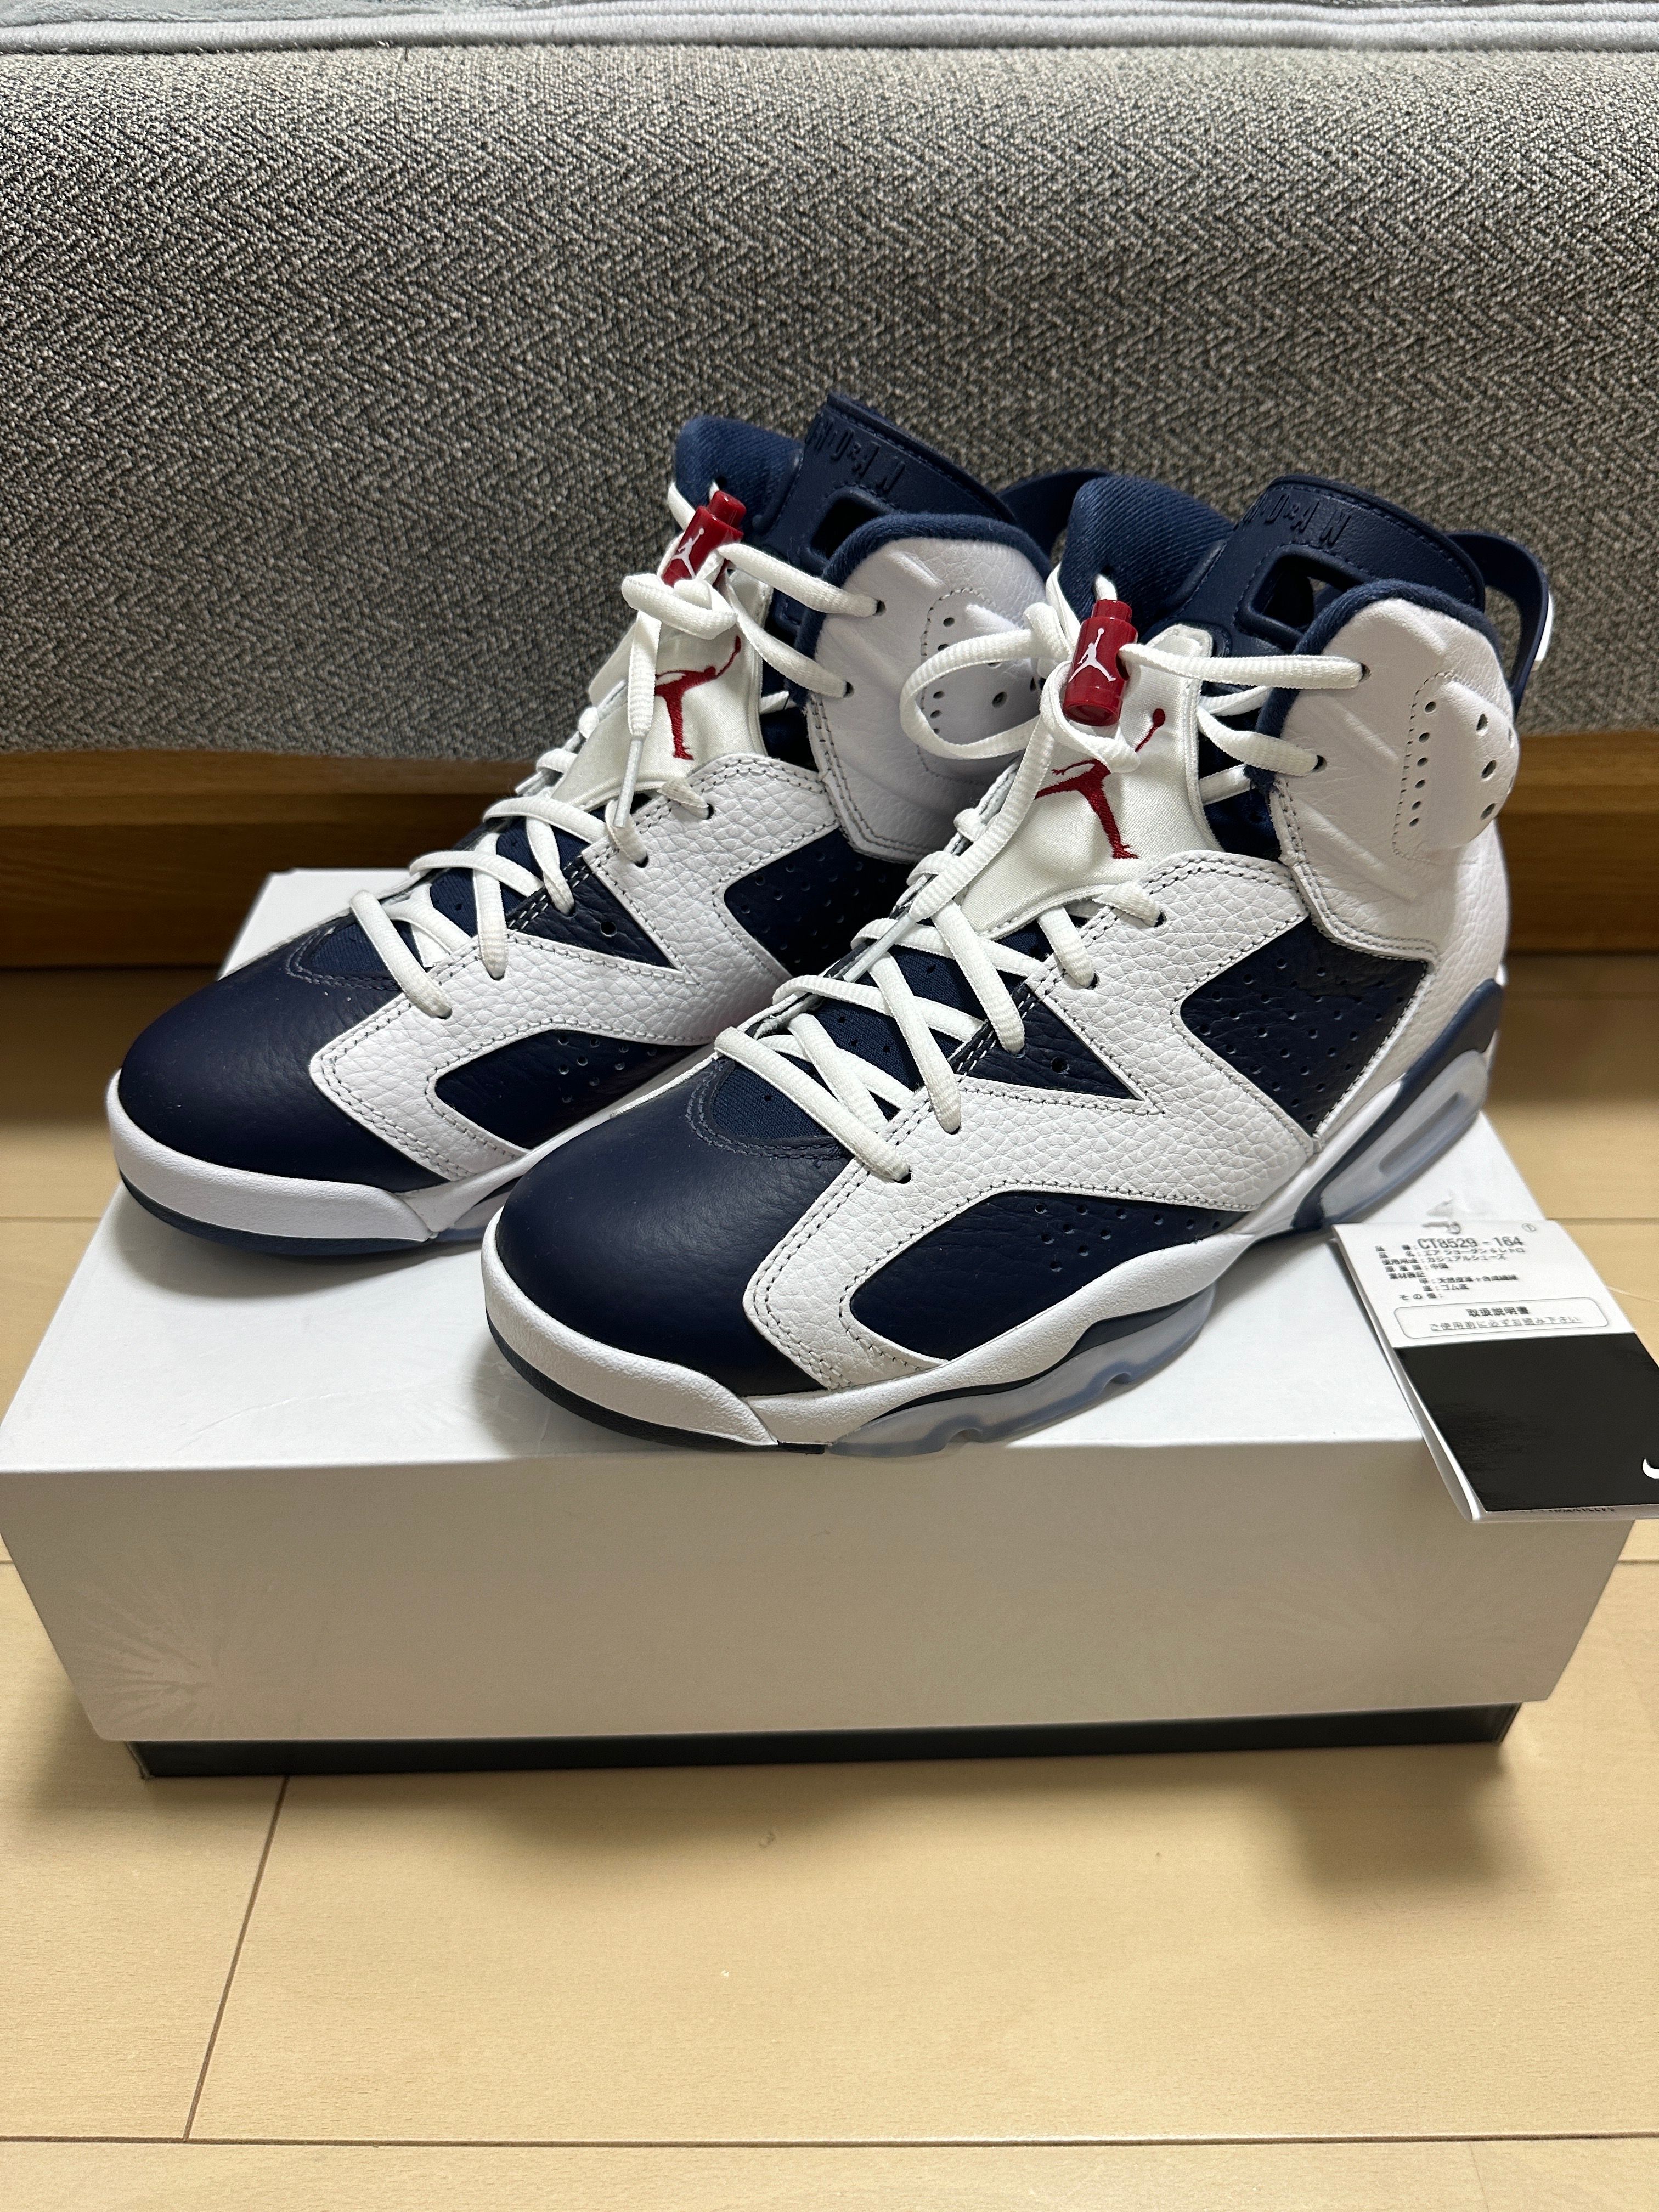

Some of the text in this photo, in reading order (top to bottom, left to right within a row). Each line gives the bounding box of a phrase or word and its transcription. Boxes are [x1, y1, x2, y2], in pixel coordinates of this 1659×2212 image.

[1465, 1306, 1529, 1317] 取扱説明書
